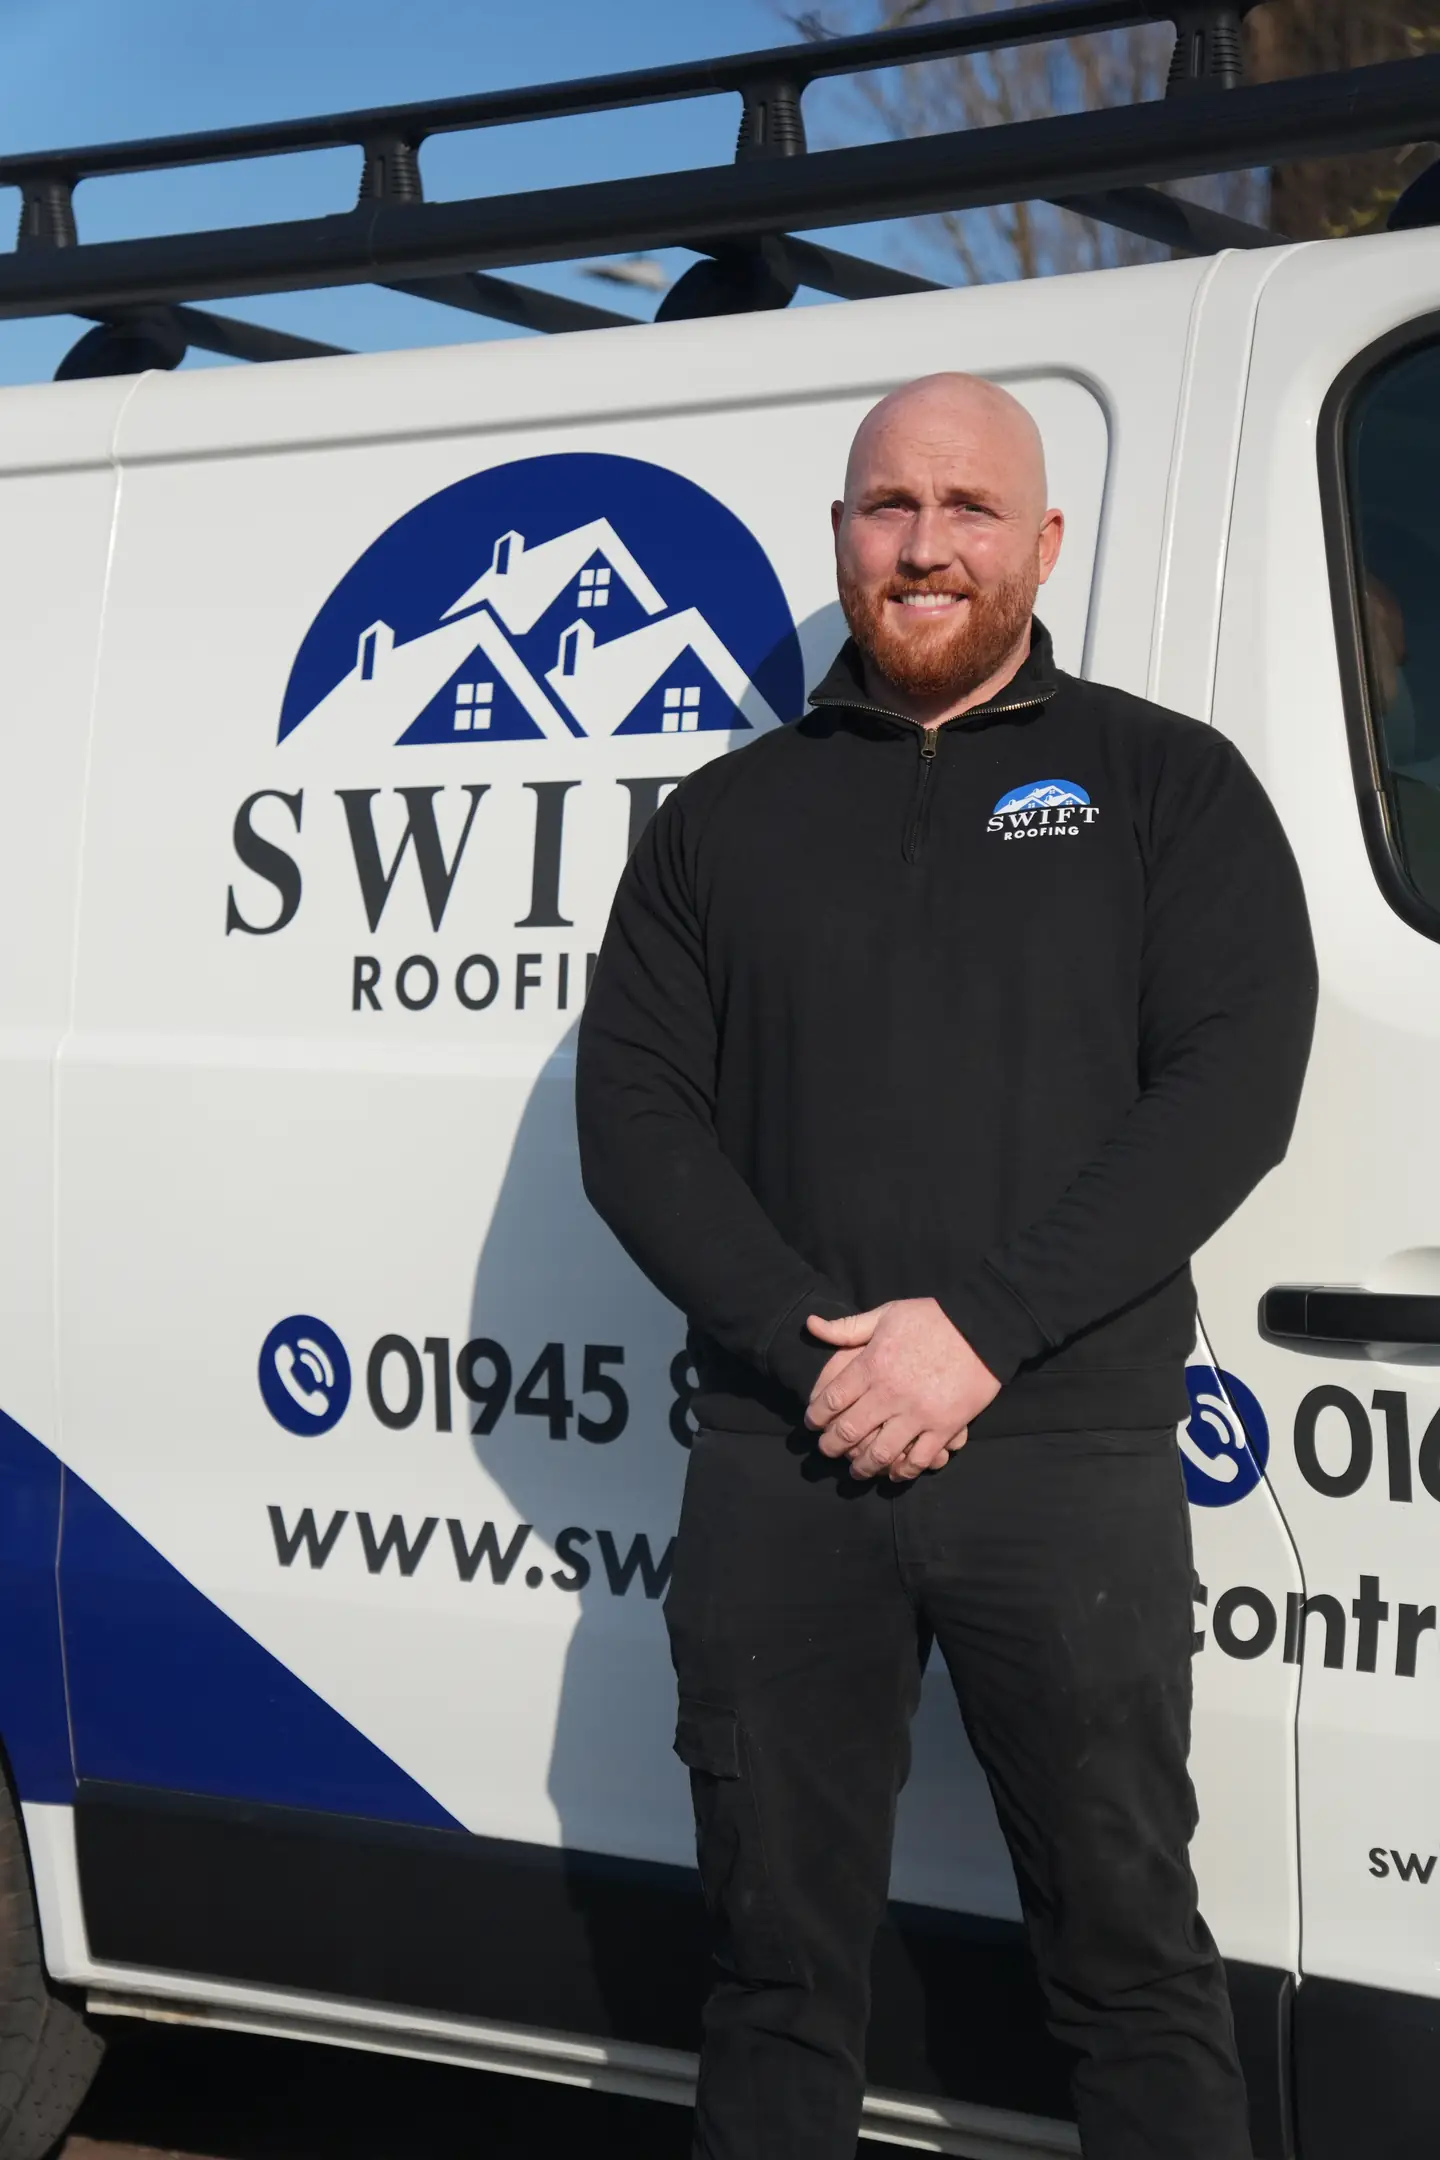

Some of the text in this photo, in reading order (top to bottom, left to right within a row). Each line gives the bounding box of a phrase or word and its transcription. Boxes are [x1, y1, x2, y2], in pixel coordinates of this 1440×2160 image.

[986, 806, 1100, 833] SWIFT
[1004, 825, 1080, 841] ROOFING
[351, 952, 599, 1012] ROOFI
[366, 1333, 630, 1445] 01945
[1293, 1384, 1440, 1504] 01
[1193, 1574, 1438, 1679] ontr
